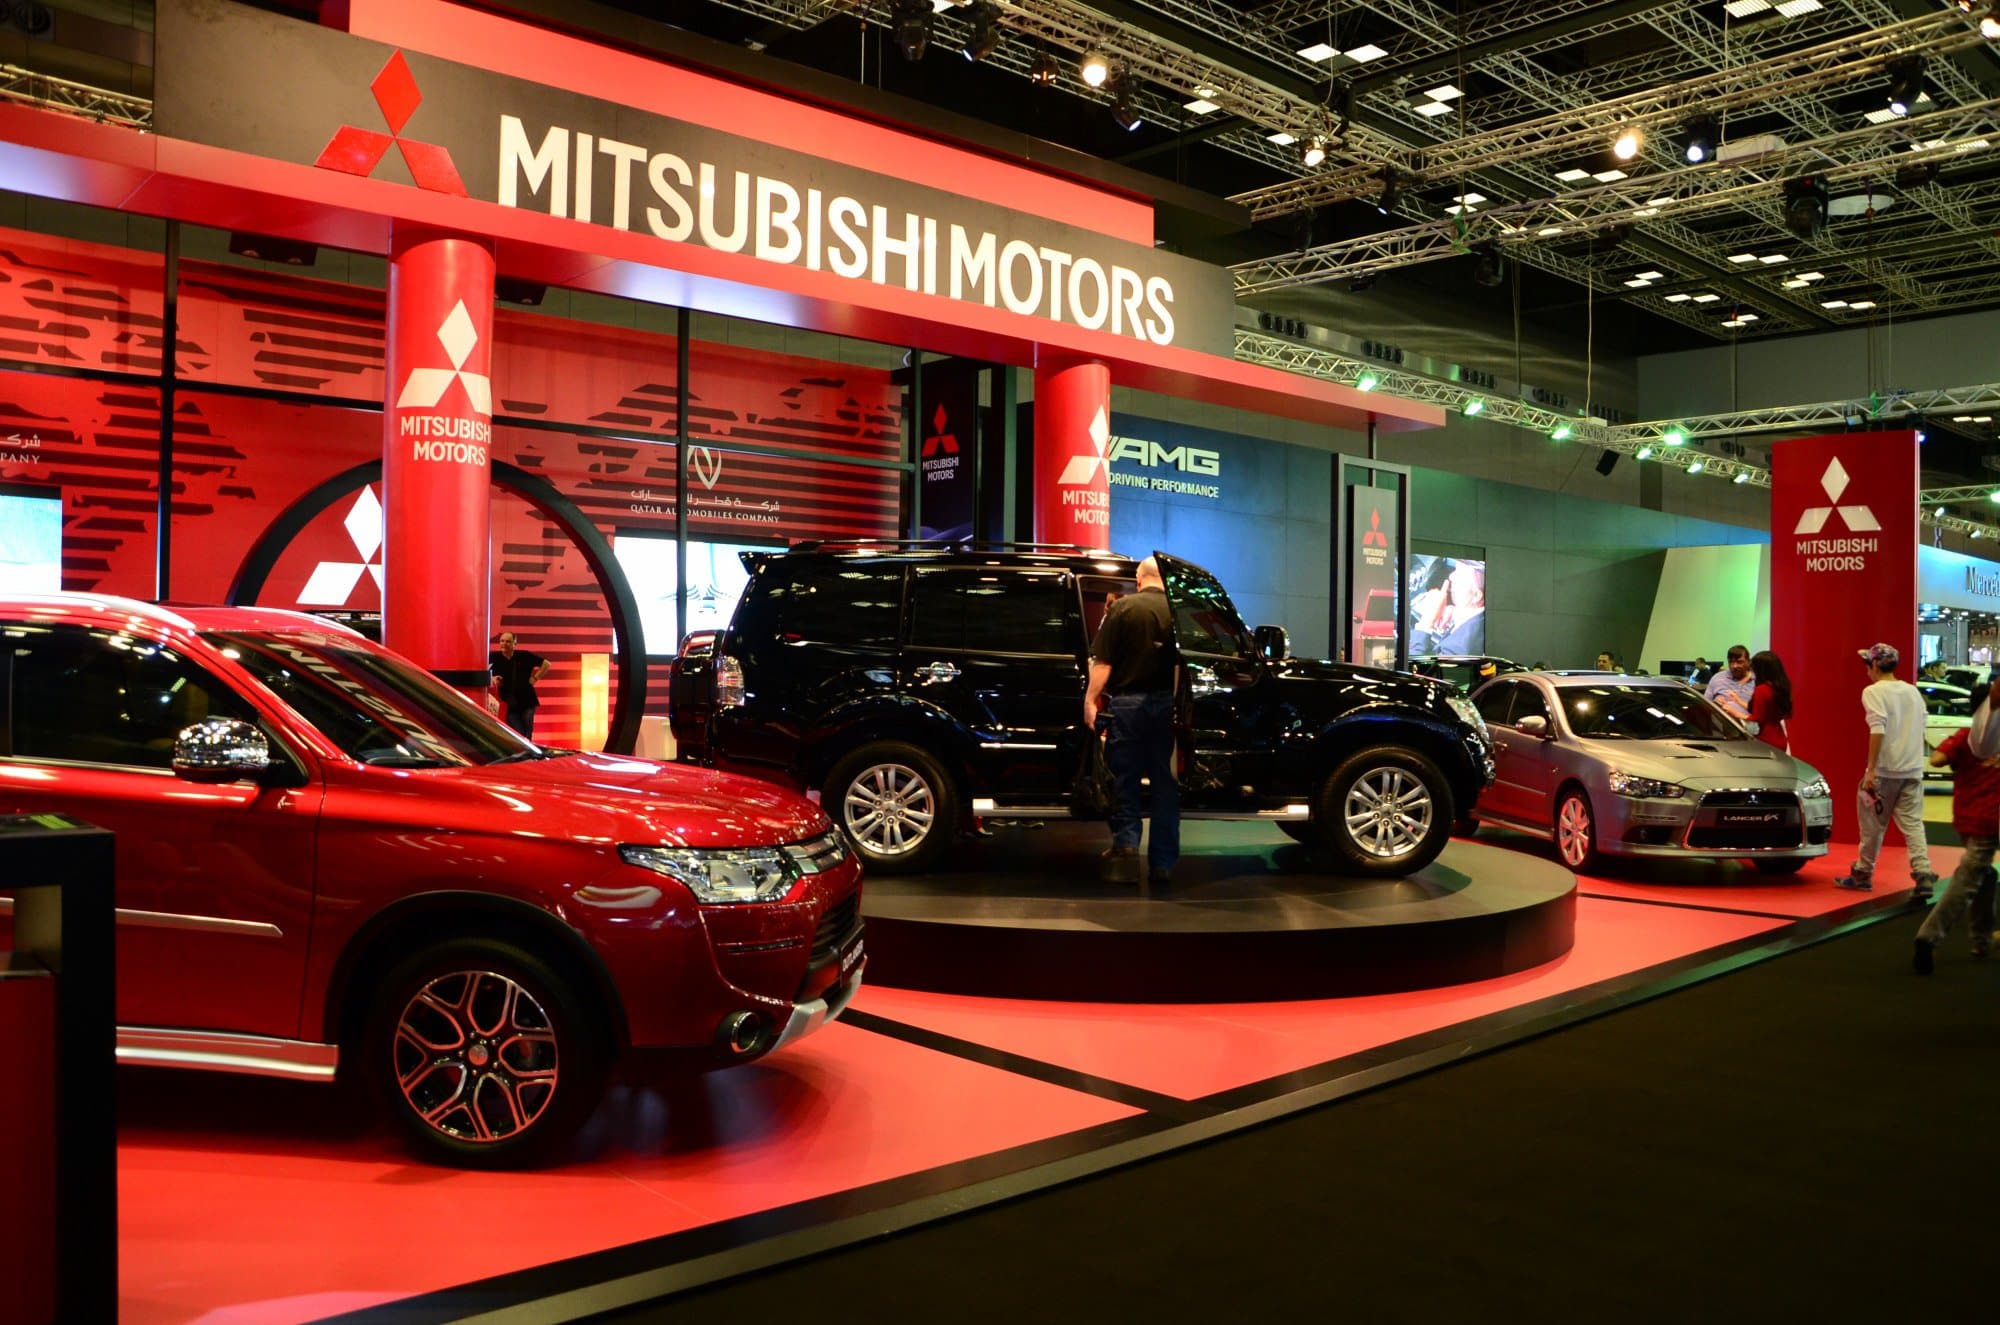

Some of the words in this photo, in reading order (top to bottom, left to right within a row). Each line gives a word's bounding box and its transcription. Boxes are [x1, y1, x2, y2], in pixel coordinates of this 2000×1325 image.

[498, 113, 937, 295] MITSUBISHI
[950, 223, 1175, 346] MOTORS
[413, 440, 487, 467] MOTORS
[922, 456, 960, 471] MITSUBISHI
[927, 469, 955, 482] MOTORS
[1109, 471, 1149, 489] DRIVING
[1150, 477, 1220, 499] PERFORMANCE
[631, 503, 662, 514] QATAR
[735, 512, 780, 524] COMPANY
[1796, 538, 1879, 556] MITSUBISHI
[1806, 556, 1866, 572] MOTORS
